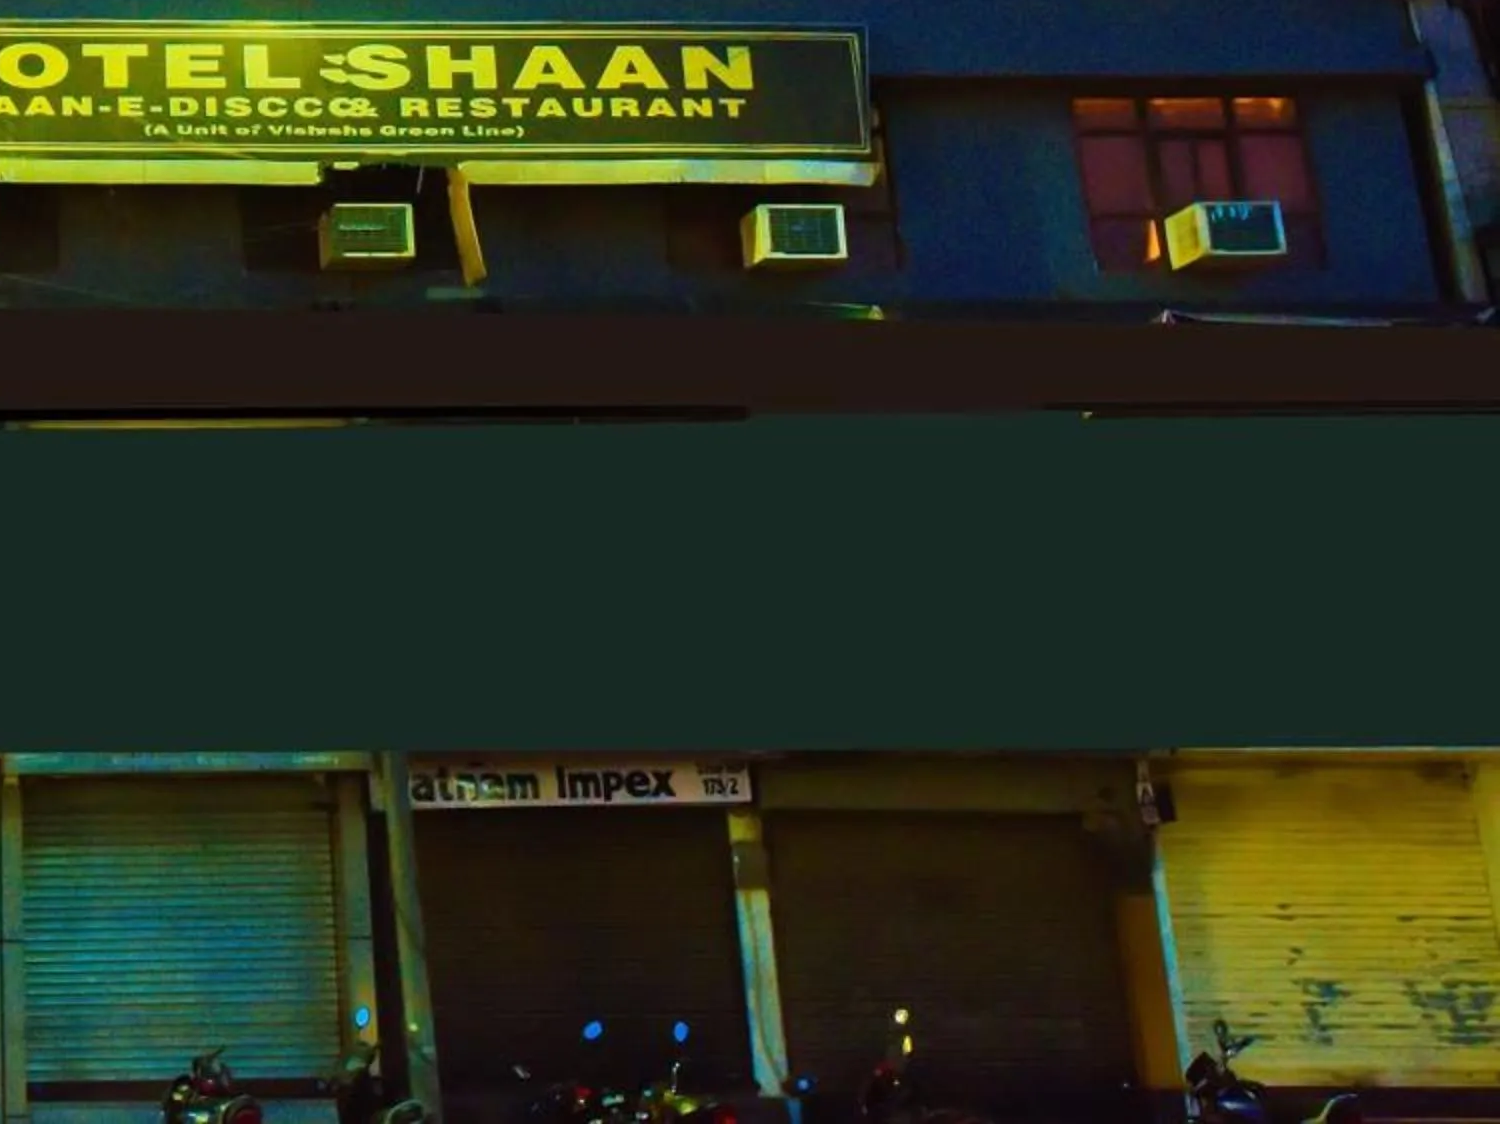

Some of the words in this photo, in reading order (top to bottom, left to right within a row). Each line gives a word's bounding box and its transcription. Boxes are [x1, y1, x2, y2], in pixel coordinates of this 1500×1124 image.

[322, 42, 754, 90] SHAAN
[400, 97, 747, 119] RESTAURANT
[177, 124, 228, 136] Unit
[235, 123, 261, 136] of
[380, 124, 454, 137] Green
[555, 764, 677, 802] Impex
